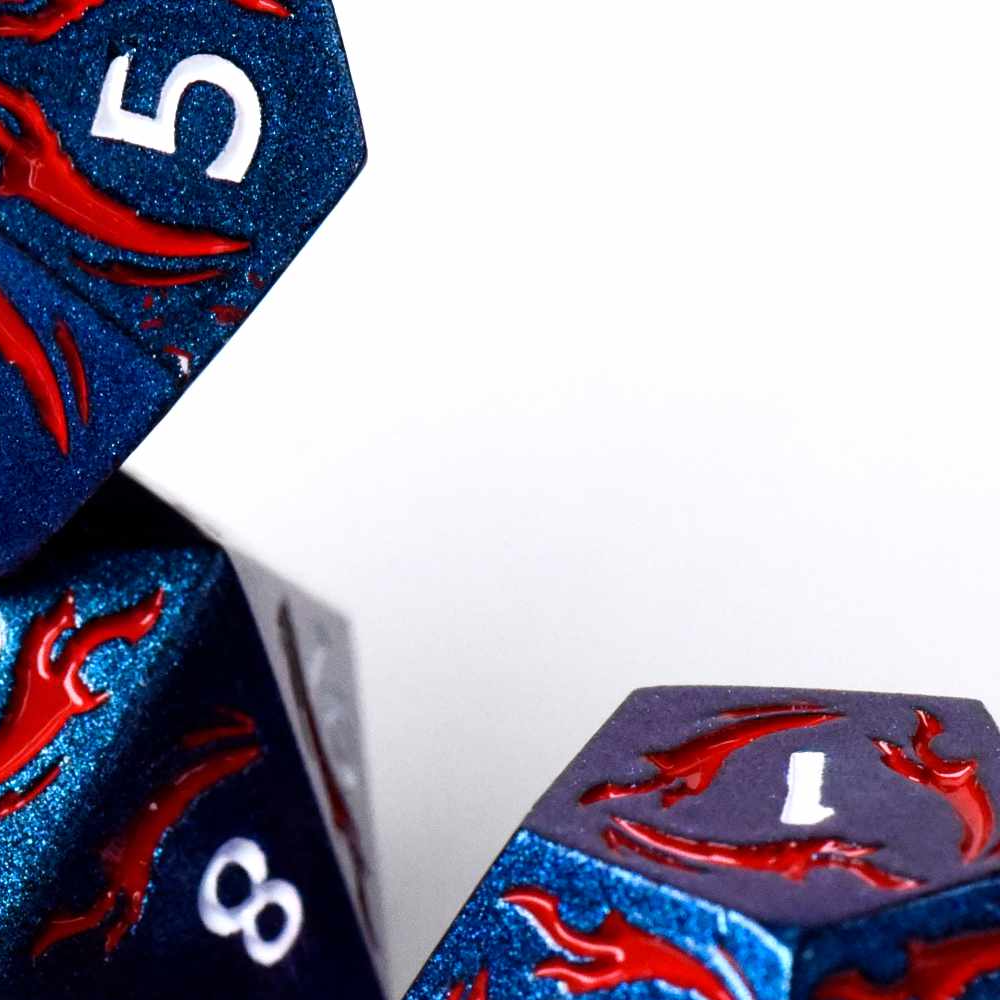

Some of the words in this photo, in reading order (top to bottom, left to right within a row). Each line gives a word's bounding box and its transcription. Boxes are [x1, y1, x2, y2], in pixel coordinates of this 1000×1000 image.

[90, 52, 263, 184] 5
[780, 751, 835, 826] 1
[199, 837, 303, 967] 8
